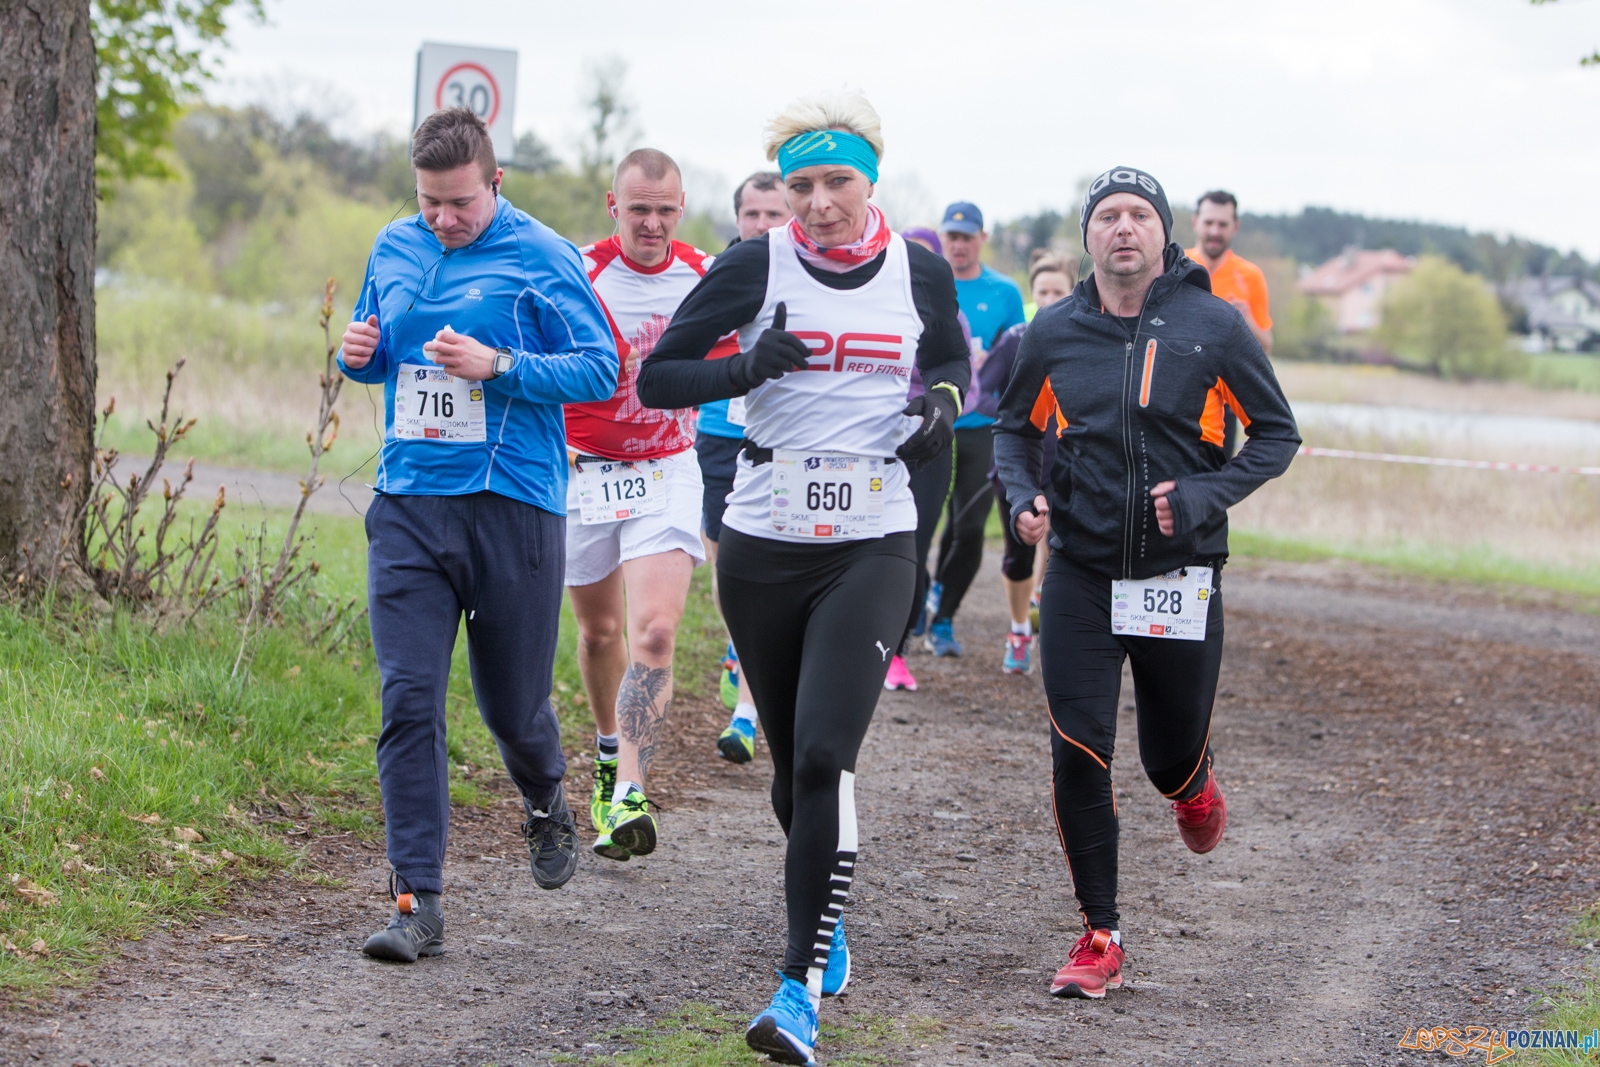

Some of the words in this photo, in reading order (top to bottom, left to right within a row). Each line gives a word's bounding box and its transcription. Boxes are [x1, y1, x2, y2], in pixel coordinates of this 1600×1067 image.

[448, 82, 489, 117] 30
[846, 362, 874, 374] RED
[417, 390, 454, 418] 716
[601, 476, 647, 503] 1123
[806, 481, 852, 512] 650
[790, 513, 808, 521] 5KM
[845, 514, 865, 522] 10KM
[1143, 588, 1183, 615] 528
